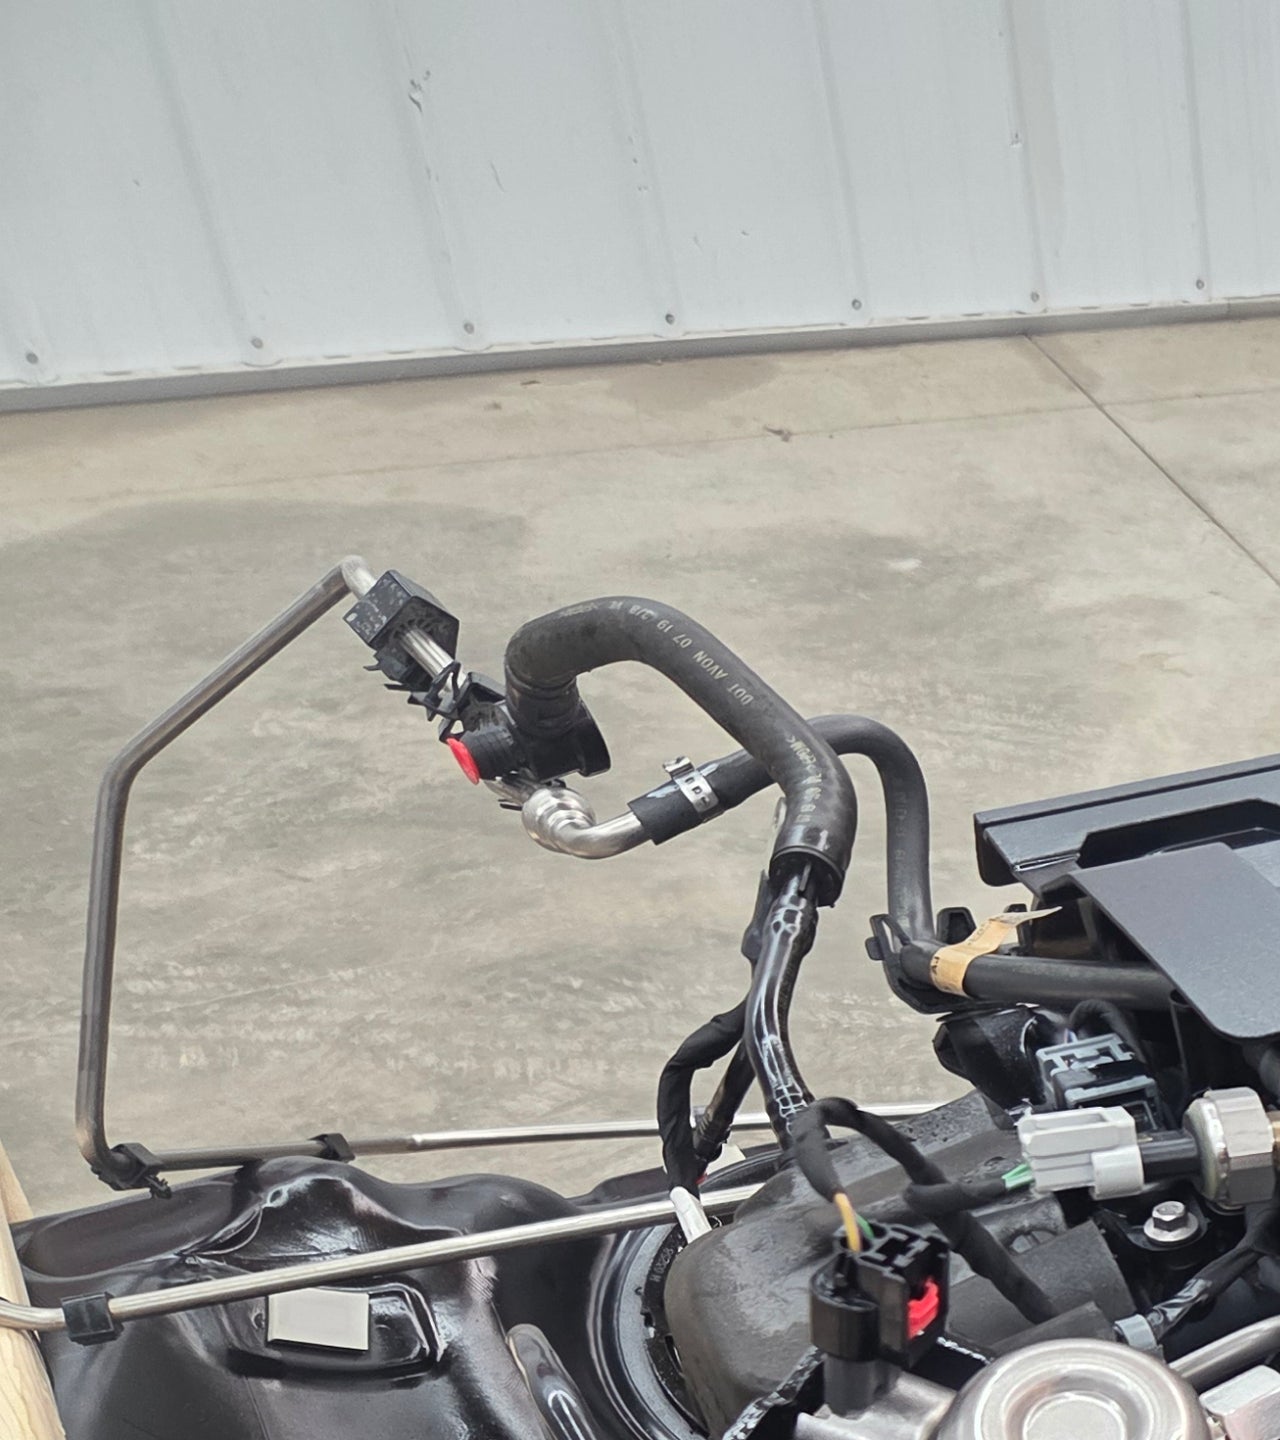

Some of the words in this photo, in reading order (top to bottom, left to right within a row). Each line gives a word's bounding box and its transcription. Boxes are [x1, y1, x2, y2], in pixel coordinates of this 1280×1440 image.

[656, 619, 674, 633] 19
[672, 633, 693, 649] 07
[692, 650, 729, 680] AVON
[727, 682, 755, 706] DOT
